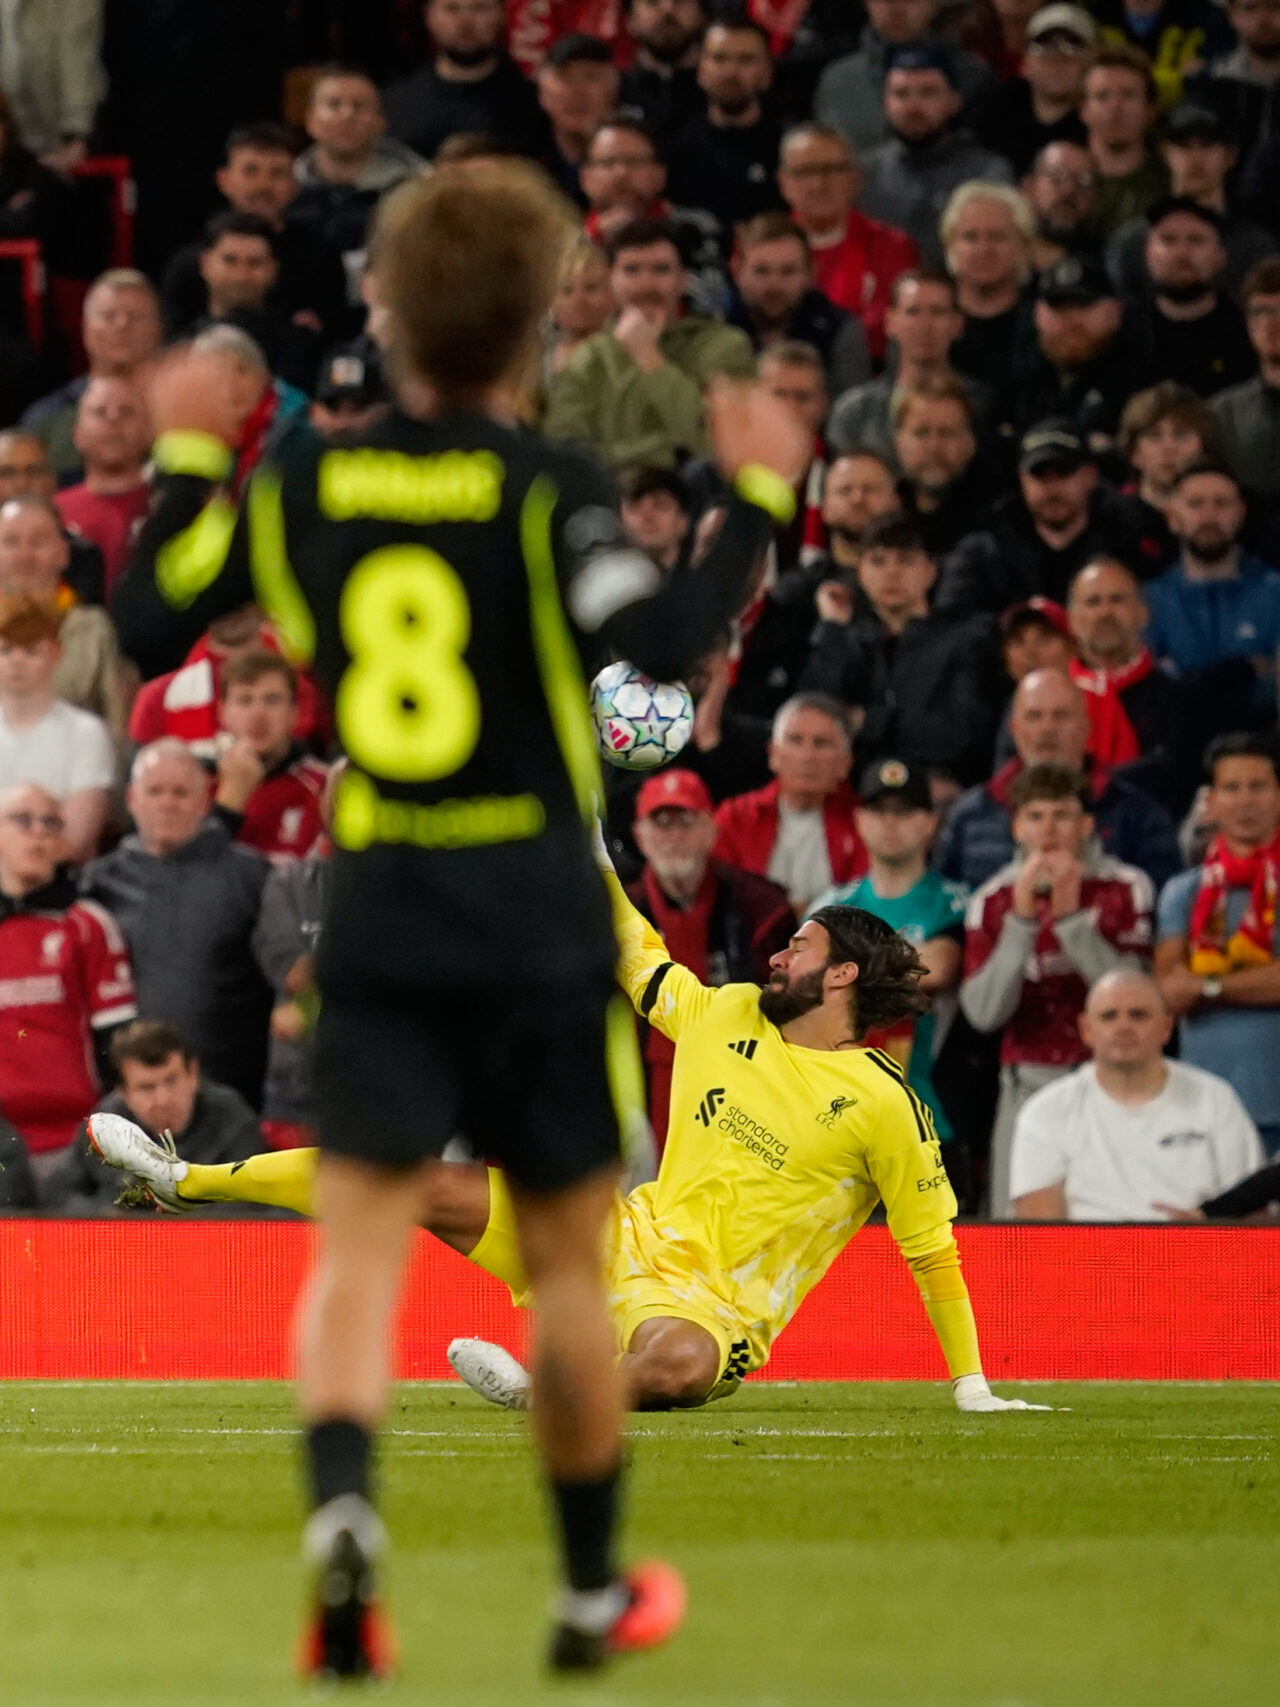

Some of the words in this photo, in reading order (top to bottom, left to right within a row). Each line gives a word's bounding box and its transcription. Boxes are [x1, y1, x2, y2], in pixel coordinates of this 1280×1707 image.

[337, 543, 481, 782] 8
[718, 1116, 785, 1171] chartered
[725, 1105, 790, 1157] standard
